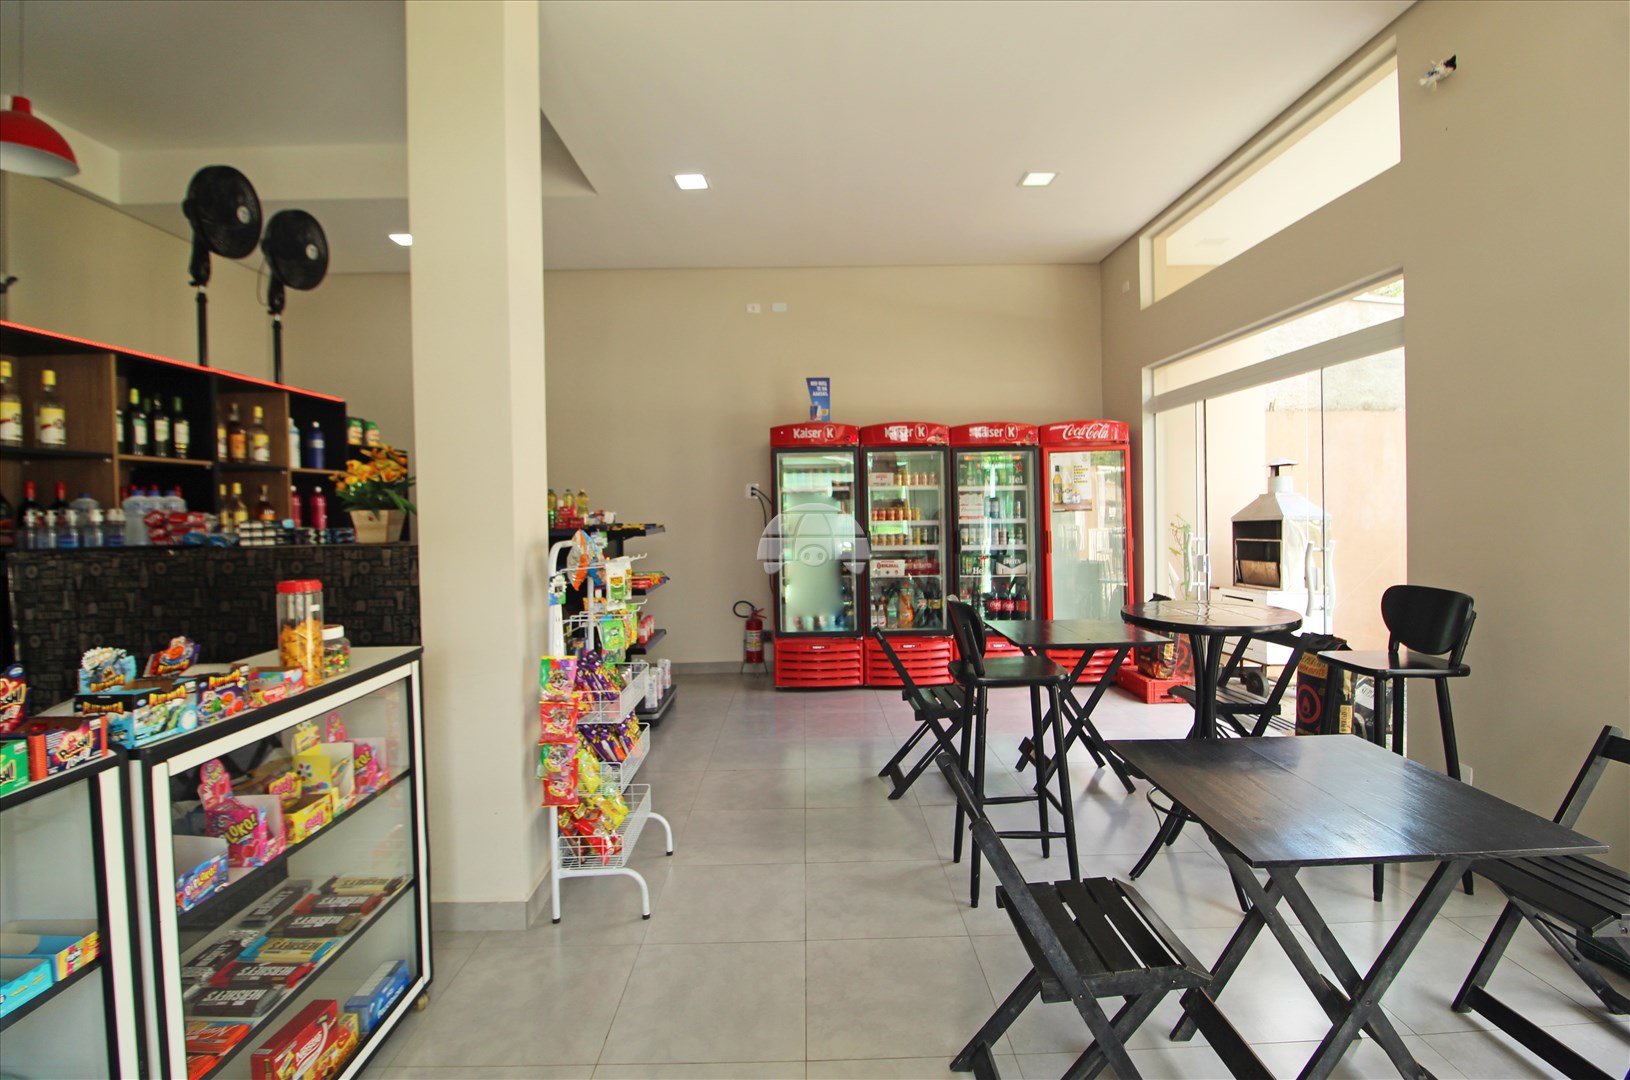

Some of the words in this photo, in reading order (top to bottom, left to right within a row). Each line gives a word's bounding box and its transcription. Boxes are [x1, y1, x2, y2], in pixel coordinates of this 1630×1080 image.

[793, 428, 822, 439] Kaiser
[224, 812, 259, 845] LOKO!
[236, 966, 298, 976] HERSHEY'S
[200, 988, 268, 1001] HERSHEY'S
